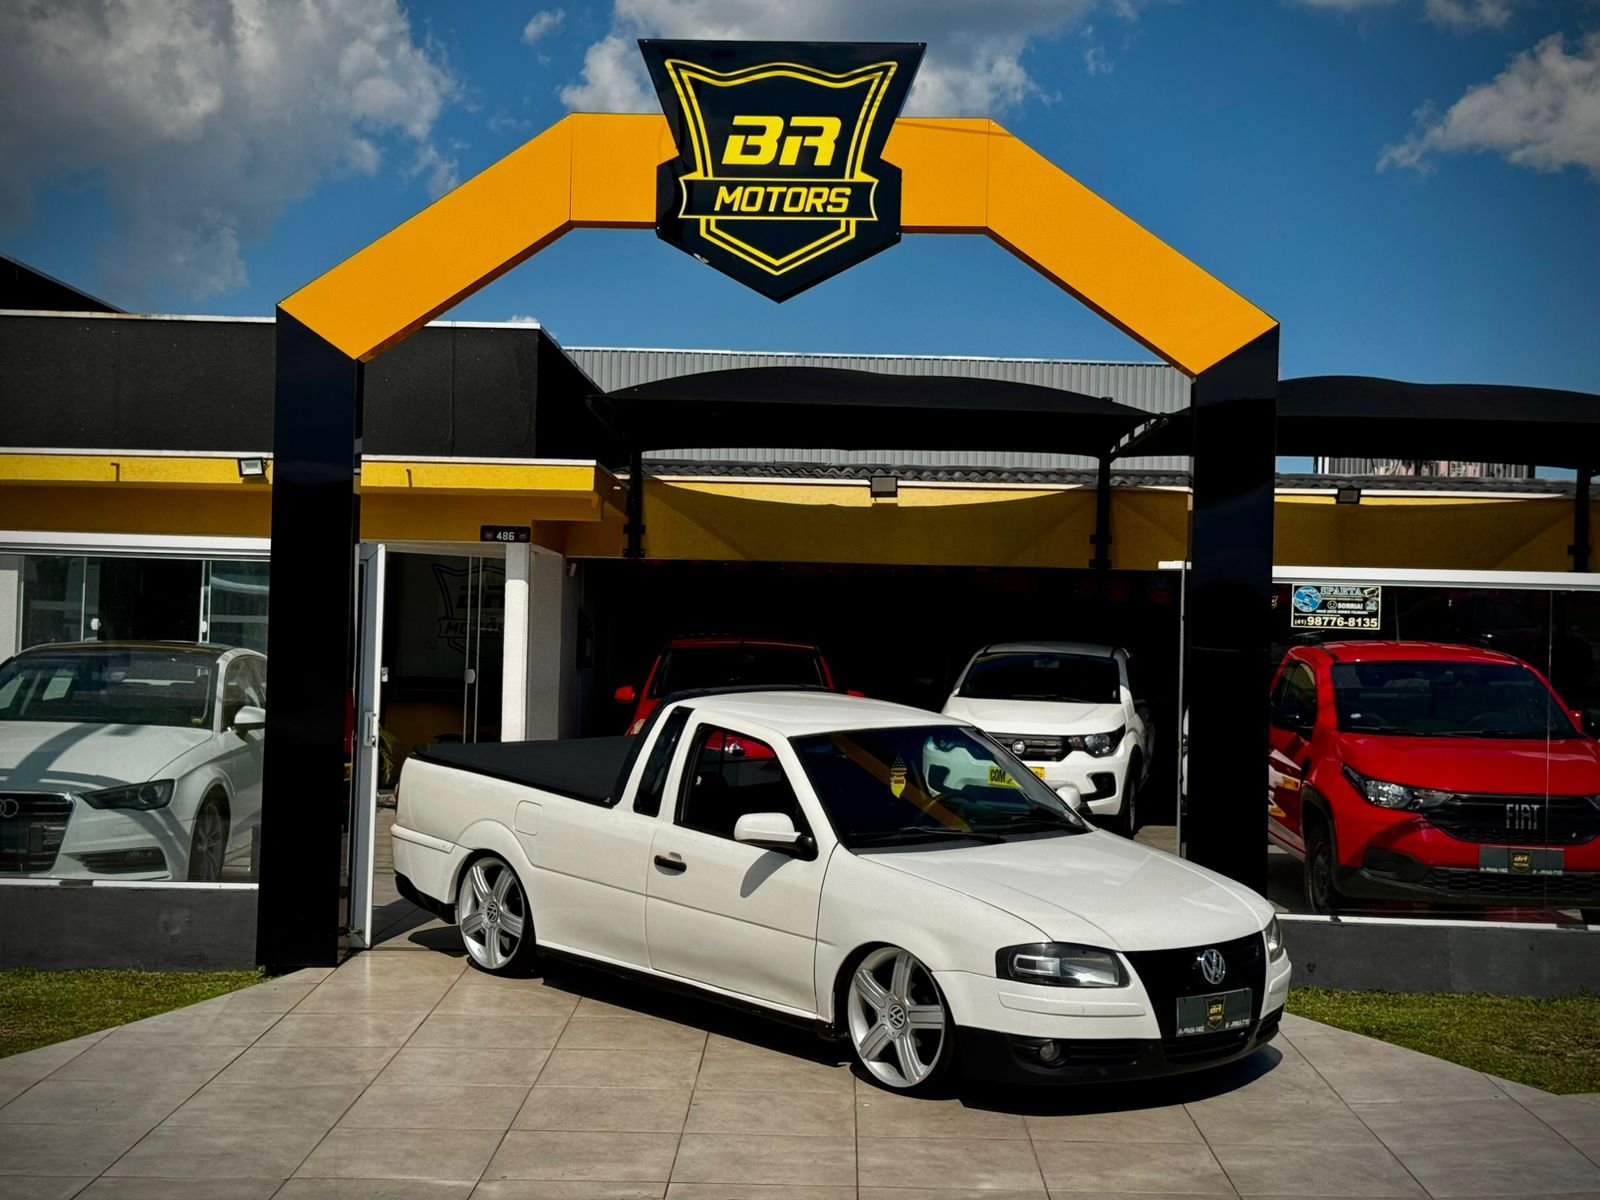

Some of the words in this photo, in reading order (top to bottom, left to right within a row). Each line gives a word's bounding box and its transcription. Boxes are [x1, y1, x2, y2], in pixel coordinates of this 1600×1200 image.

[722, 115, 841, 166] BR
[714, 186, 851, 213] MOTORS
[496, 531, 515, 541] 486
[1320, 586, 1363, 596] SPARTA
[1307, 617, 1377, 628] 98776-8135
[1506, 803, 1540, 830] FIAT
